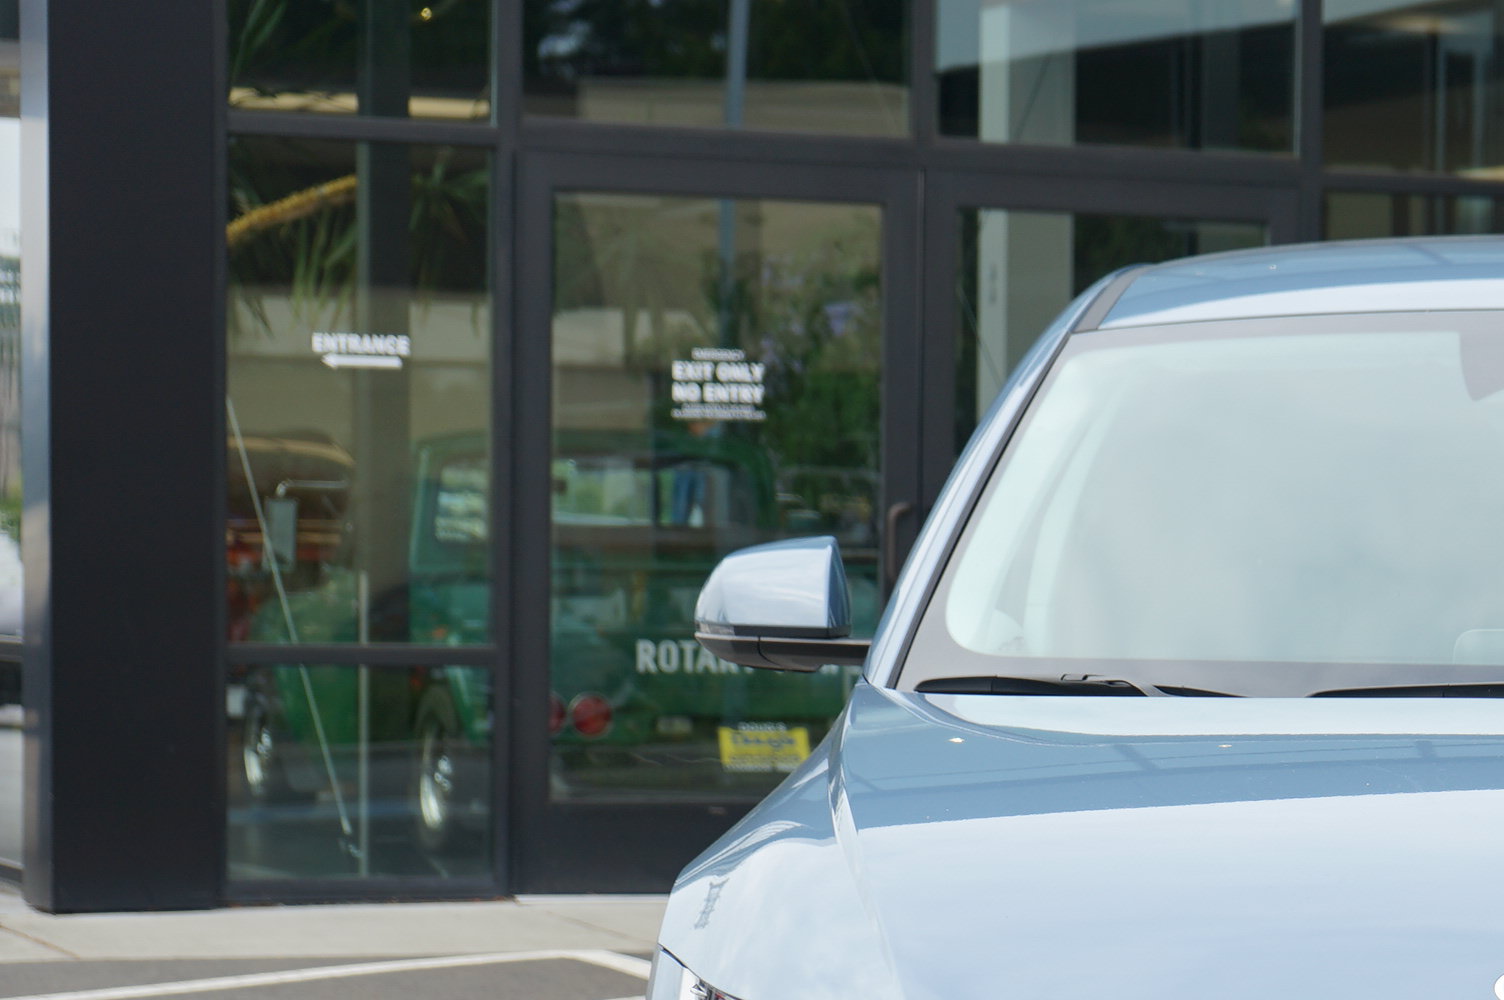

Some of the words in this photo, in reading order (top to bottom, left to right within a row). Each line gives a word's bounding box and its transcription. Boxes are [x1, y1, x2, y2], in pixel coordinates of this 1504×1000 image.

[312, 332, 410, 356] ENTRANCE
[672, 360, 714, 381] EXIT
[716, 361, 765, 382] ONLY
[672, 382, 701, 402] NO
[703, 382, 765, 404] ENTRY
